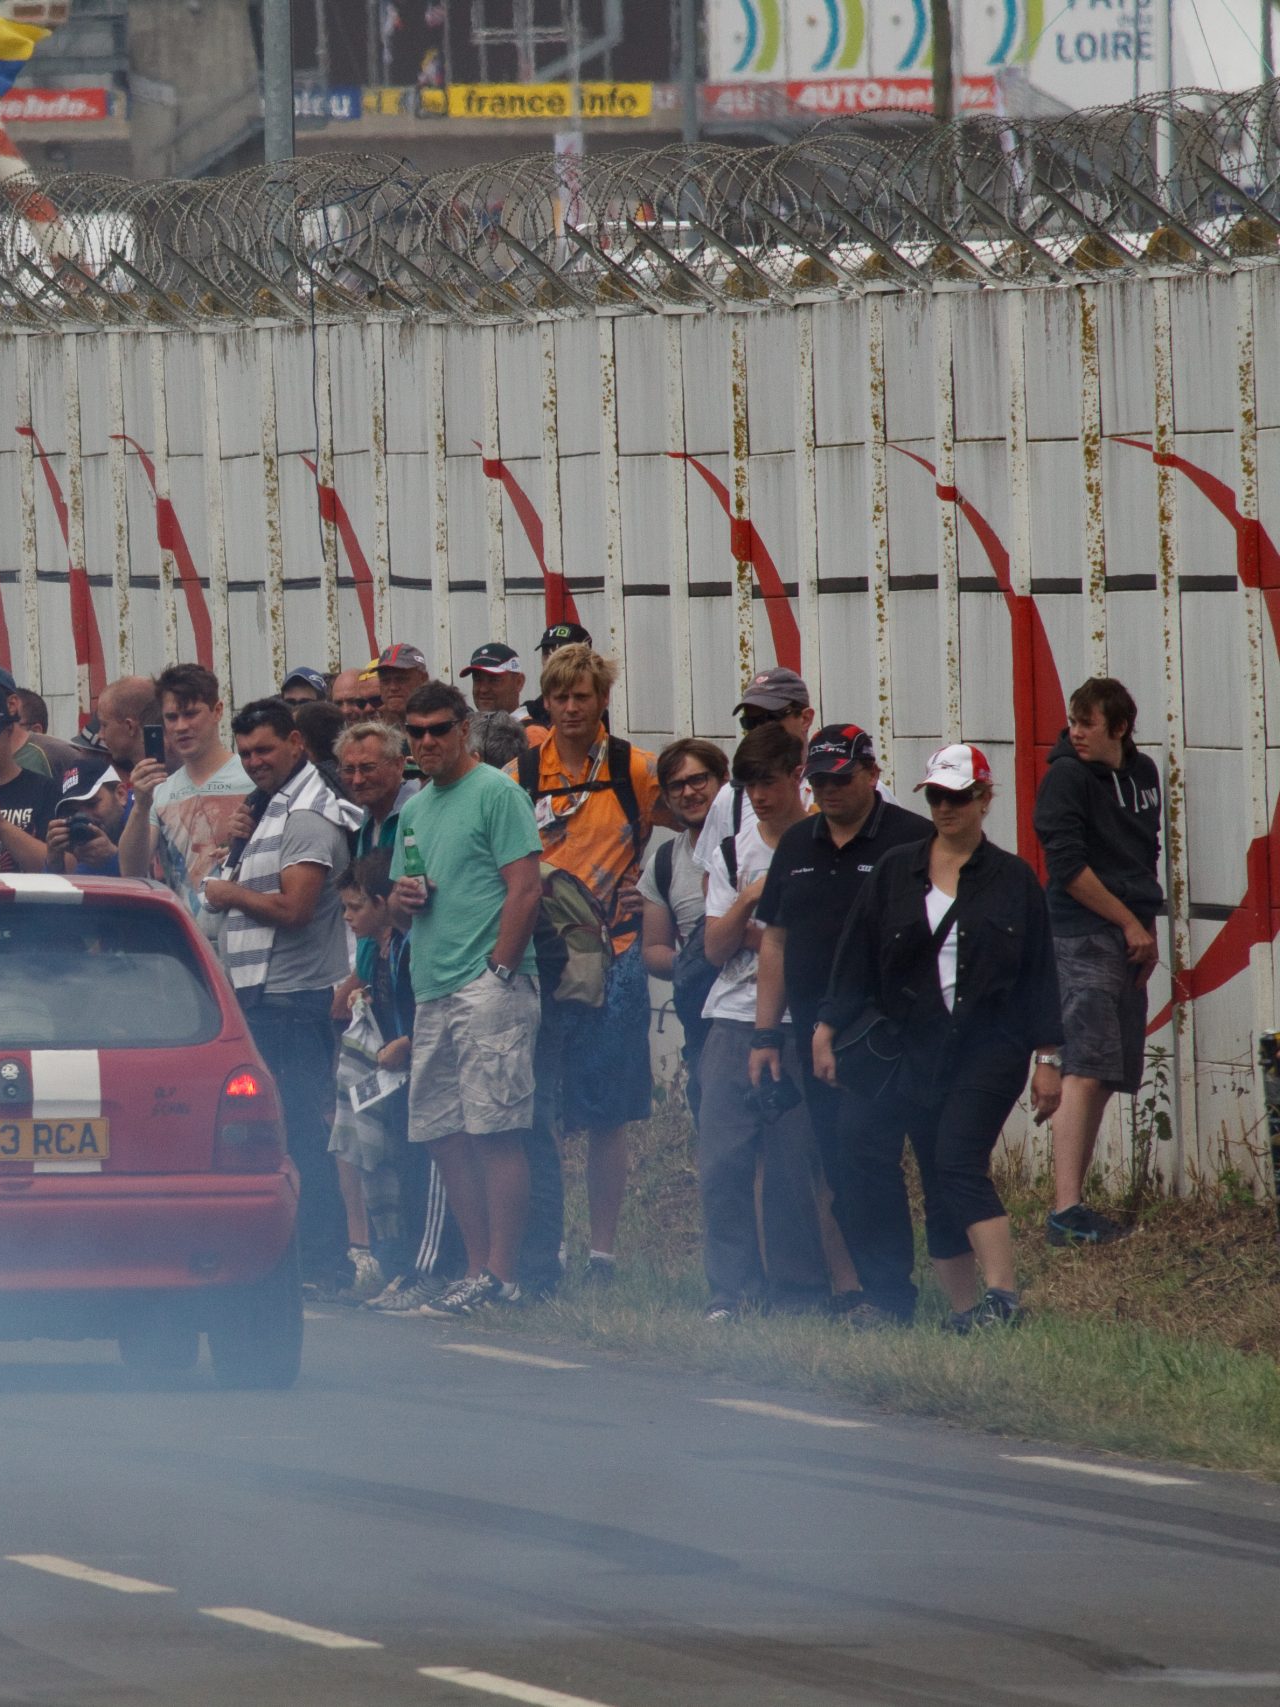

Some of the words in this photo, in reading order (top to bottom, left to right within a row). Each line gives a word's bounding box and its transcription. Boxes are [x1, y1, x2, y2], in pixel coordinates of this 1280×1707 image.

[1056, 31, 1152, 64] LOIRE
[465, 89, 565, 114] france
[579, 87, 637, 112] info
[33, 1122, 99, 1155] RCA
